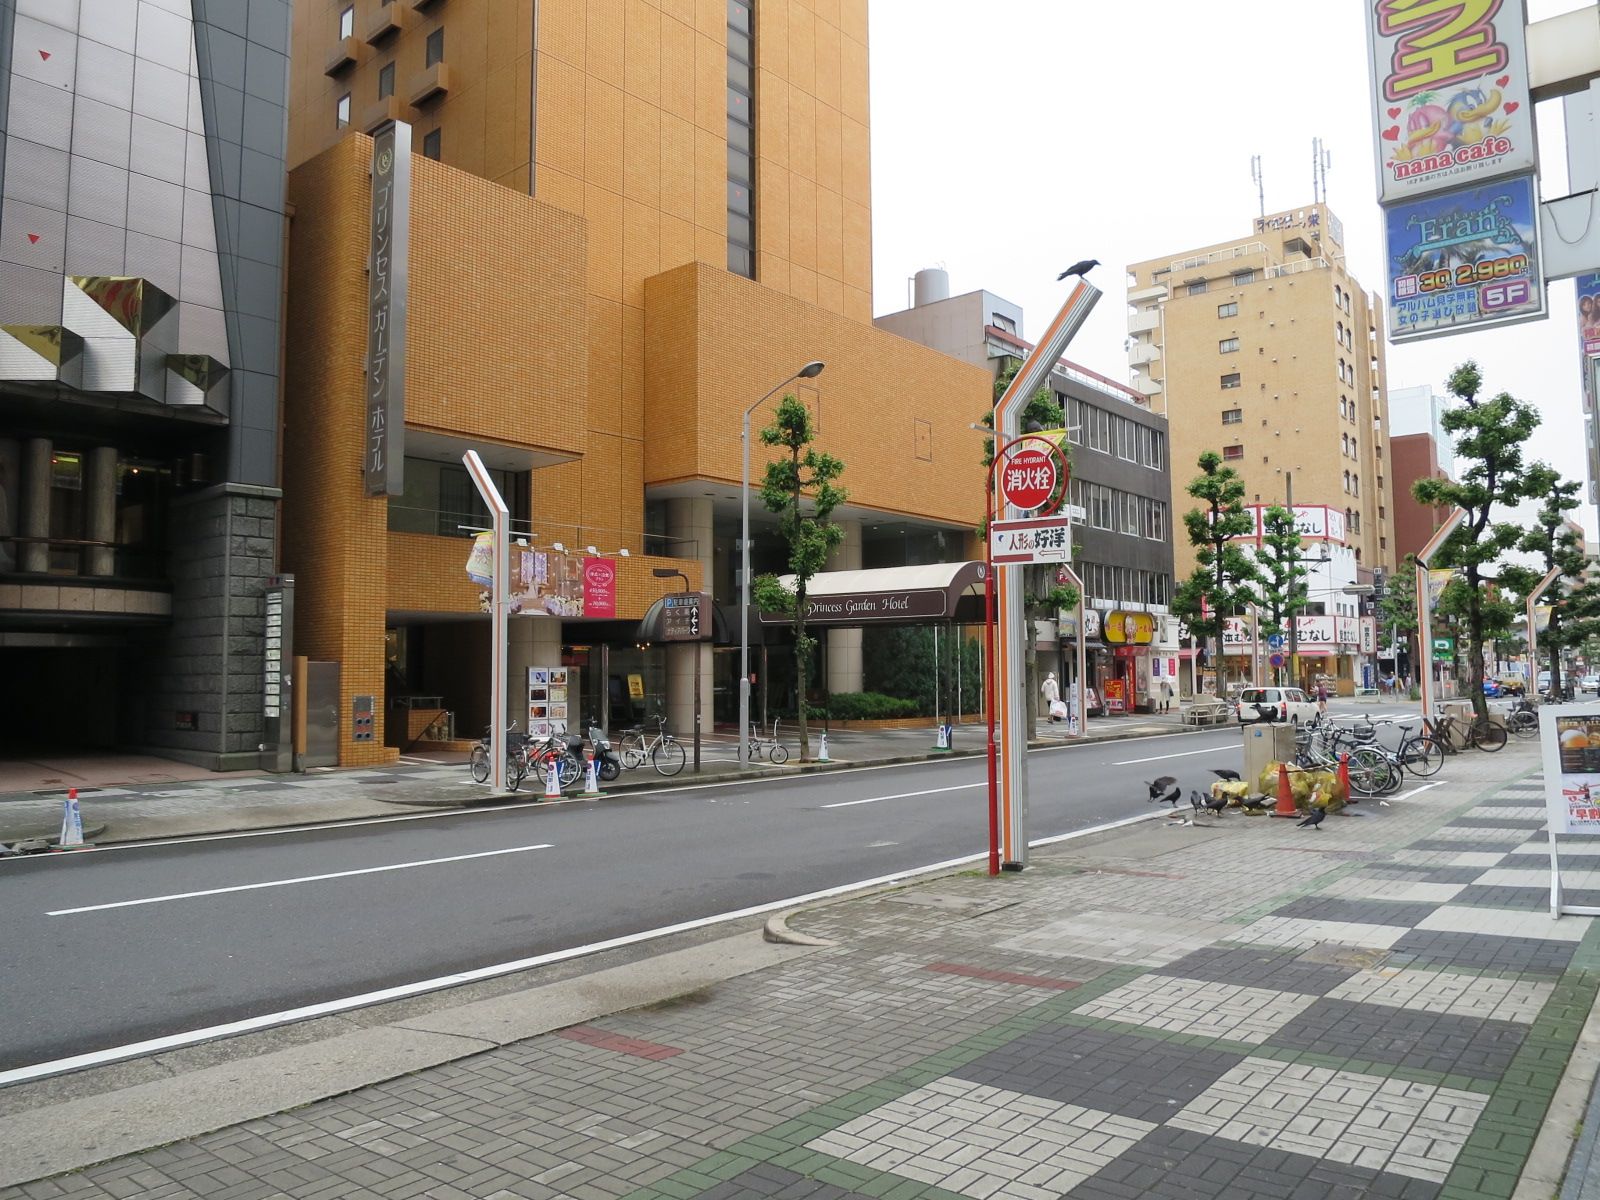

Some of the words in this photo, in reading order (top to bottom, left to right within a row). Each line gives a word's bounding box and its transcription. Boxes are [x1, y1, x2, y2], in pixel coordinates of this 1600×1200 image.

[1396, 152, 1452, 178] nana
[1456, 138, 1510, 164] cafe
[374, 180, 392, 300] プリンセス
[1486, 284, 1524, 306] 5F
[373, 305, 388, 398] ガーデン
[371, 406, 384, 473] ホテル
[1023, 456, 1046, 464] HYDRANT
[1007, 466, 1051, 492] 消火栓
[1009, 526, 1066, 551] 人形の好洋
[808, 600, 842, 617] Princess
[845, 600, 876, 615] Garden
[882, 596, 909, 610] Hotel
